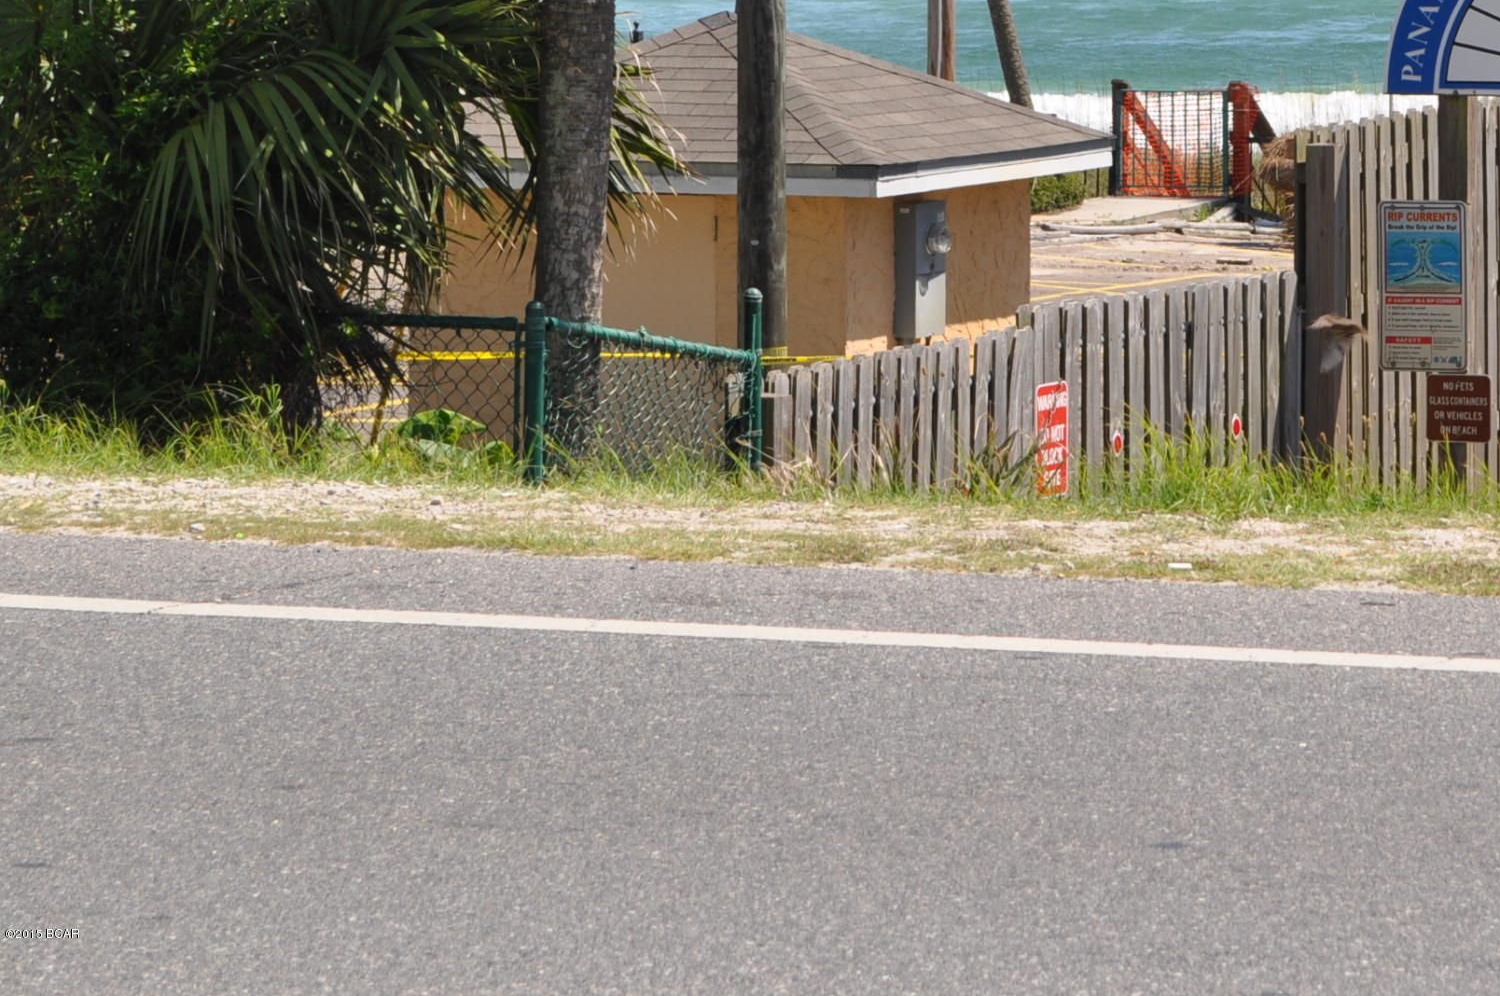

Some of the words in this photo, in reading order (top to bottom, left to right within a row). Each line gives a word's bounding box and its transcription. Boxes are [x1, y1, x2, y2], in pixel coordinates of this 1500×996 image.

[1387, 212, 1404, 221] RIP
[1407, 212, 1458, 222] CURRENTS
[1443, 381, 1454, 391] NO
[1455, 381, 1475, 392] PETS
[1429, 395, 1450, 405] GLASS
[1450, 396, 1488, 406] CONTAINERS
[1434, 410, 1445, 420] OR
[1446, 411, 1483, 421] VEHICLES
[1452, 425, 1478, 435] BEACH
